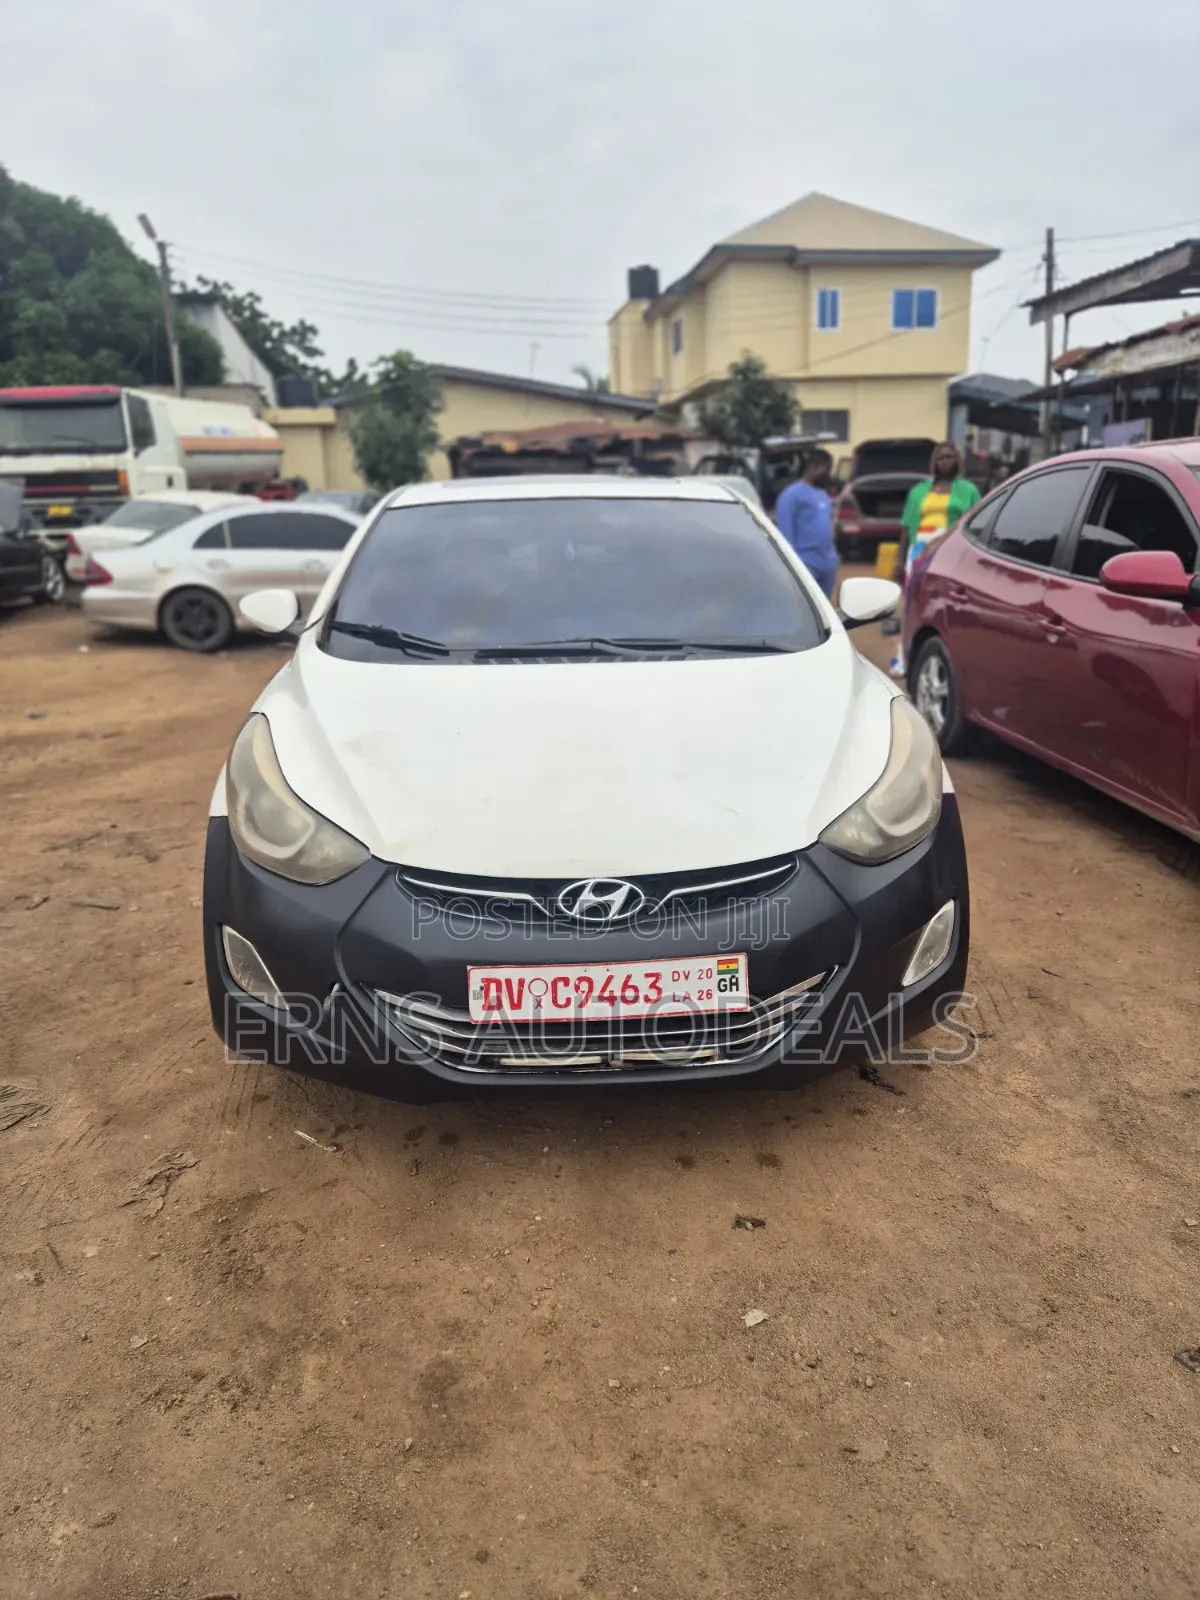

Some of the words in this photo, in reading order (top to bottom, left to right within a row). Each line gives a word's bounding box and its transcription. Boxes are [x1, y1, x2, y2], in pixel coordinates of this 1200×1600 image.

[672, 970, 690, 982] DV
[697, 968, 713, 980] 20
[481, 977, 526, 1011] DV
[551, 972, 663, 1010] C9463
[672, 990, 692, 1003] LA
[697, 989, 713, 1001] 26
